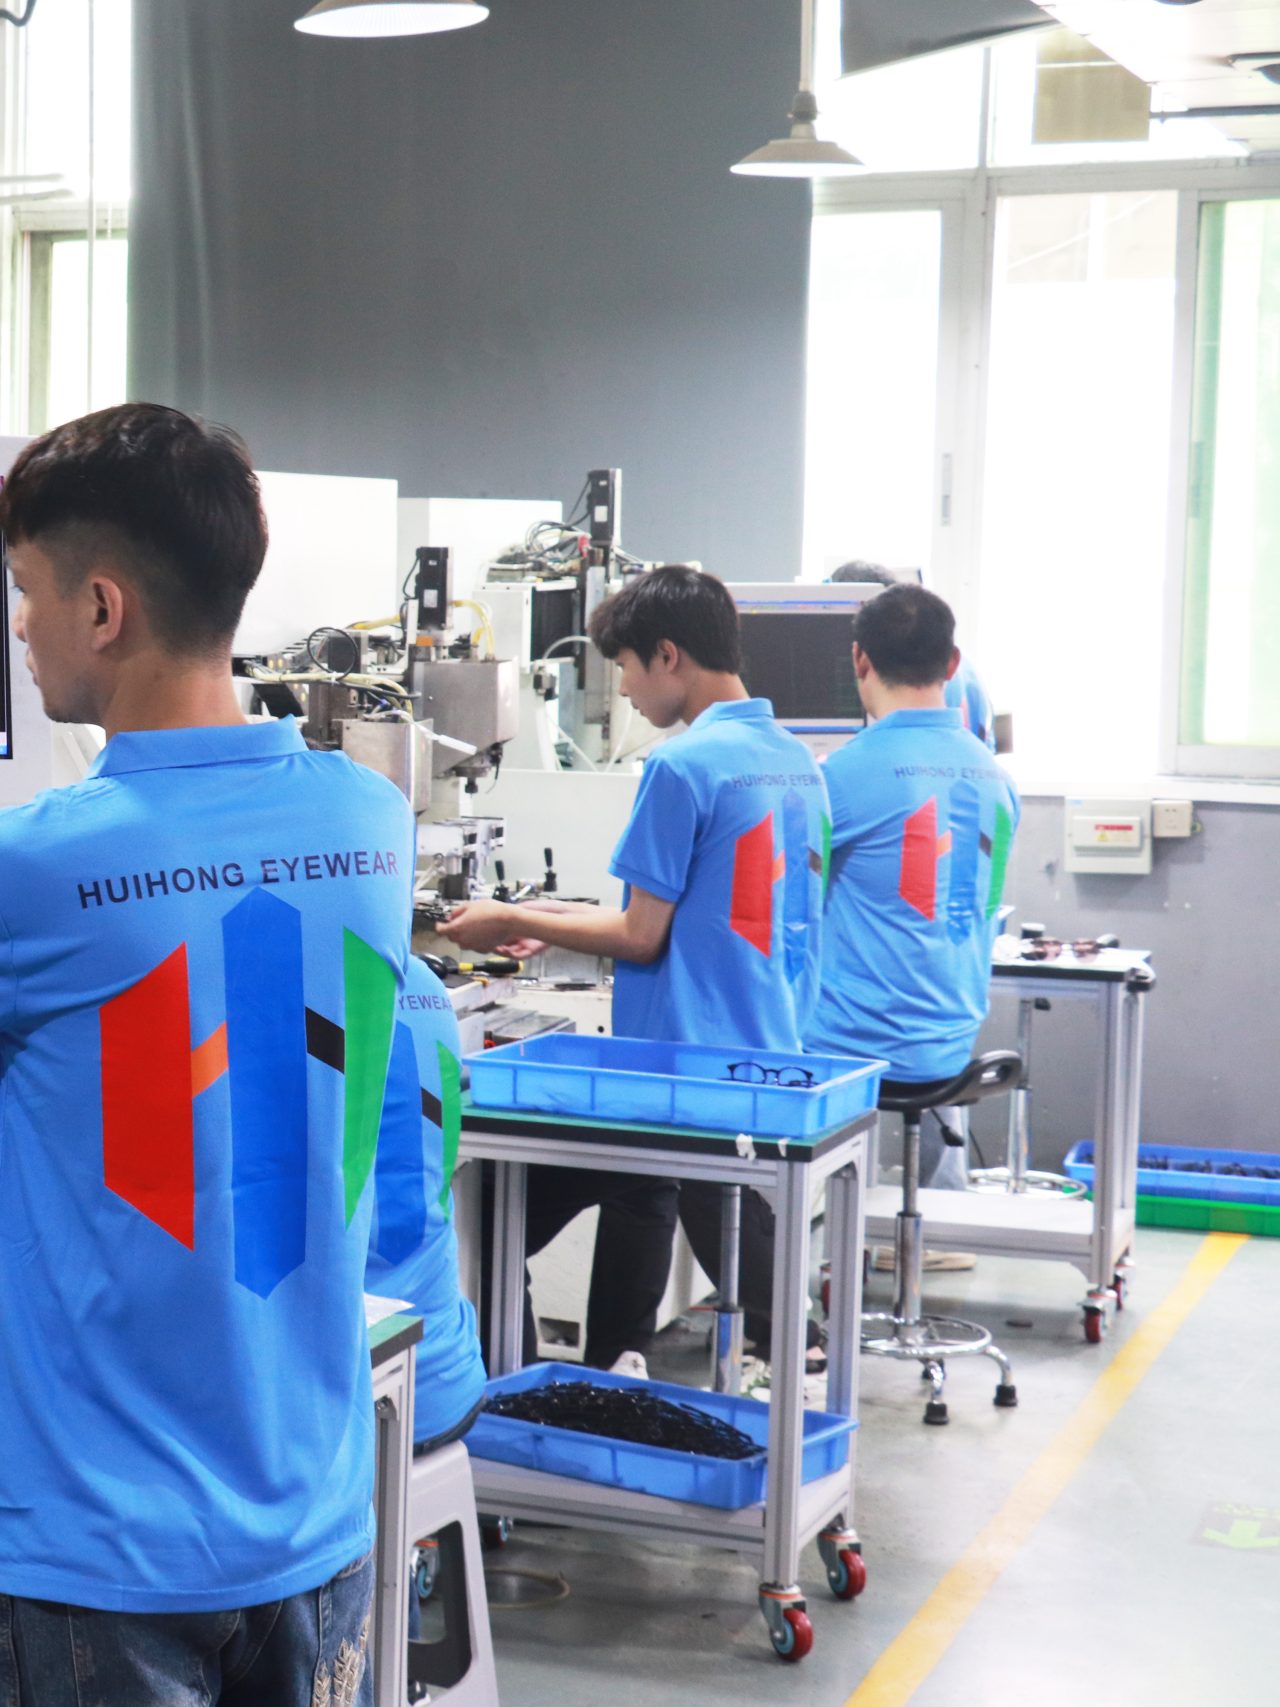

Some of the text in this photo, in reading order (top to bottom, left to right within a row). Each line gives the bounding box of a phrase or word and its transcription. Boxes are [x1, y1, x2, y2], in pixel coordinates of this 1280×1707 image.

[731, 774, 787, 789] HUIHONG
[77, 850, 399, 909] HUIHONG EYEWEAR
